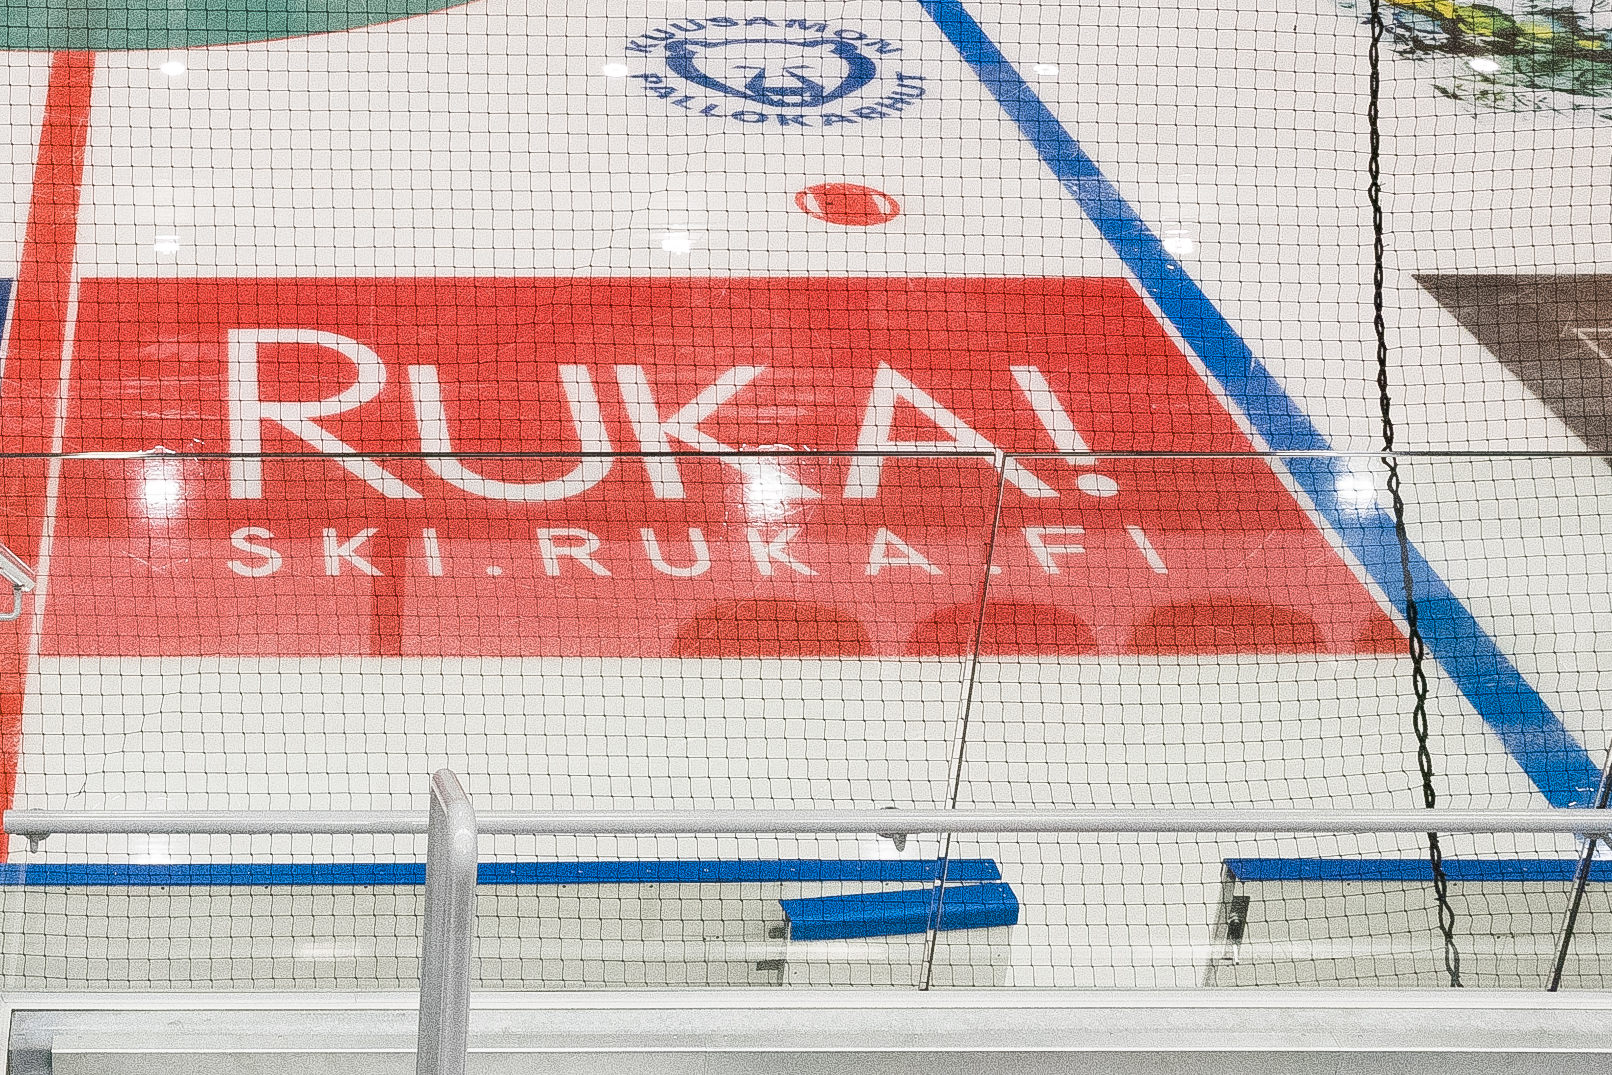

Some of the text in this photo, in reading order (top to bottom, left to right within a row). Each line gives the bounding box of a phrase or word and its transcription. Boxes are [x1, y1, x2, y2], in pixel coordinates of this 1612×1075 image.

[625, 16, 903, 55] KUUSAMON
[225, 327, 1122, 501] RUKA!
[227, 525, 1170, 578] SKI.RUKA.FI
